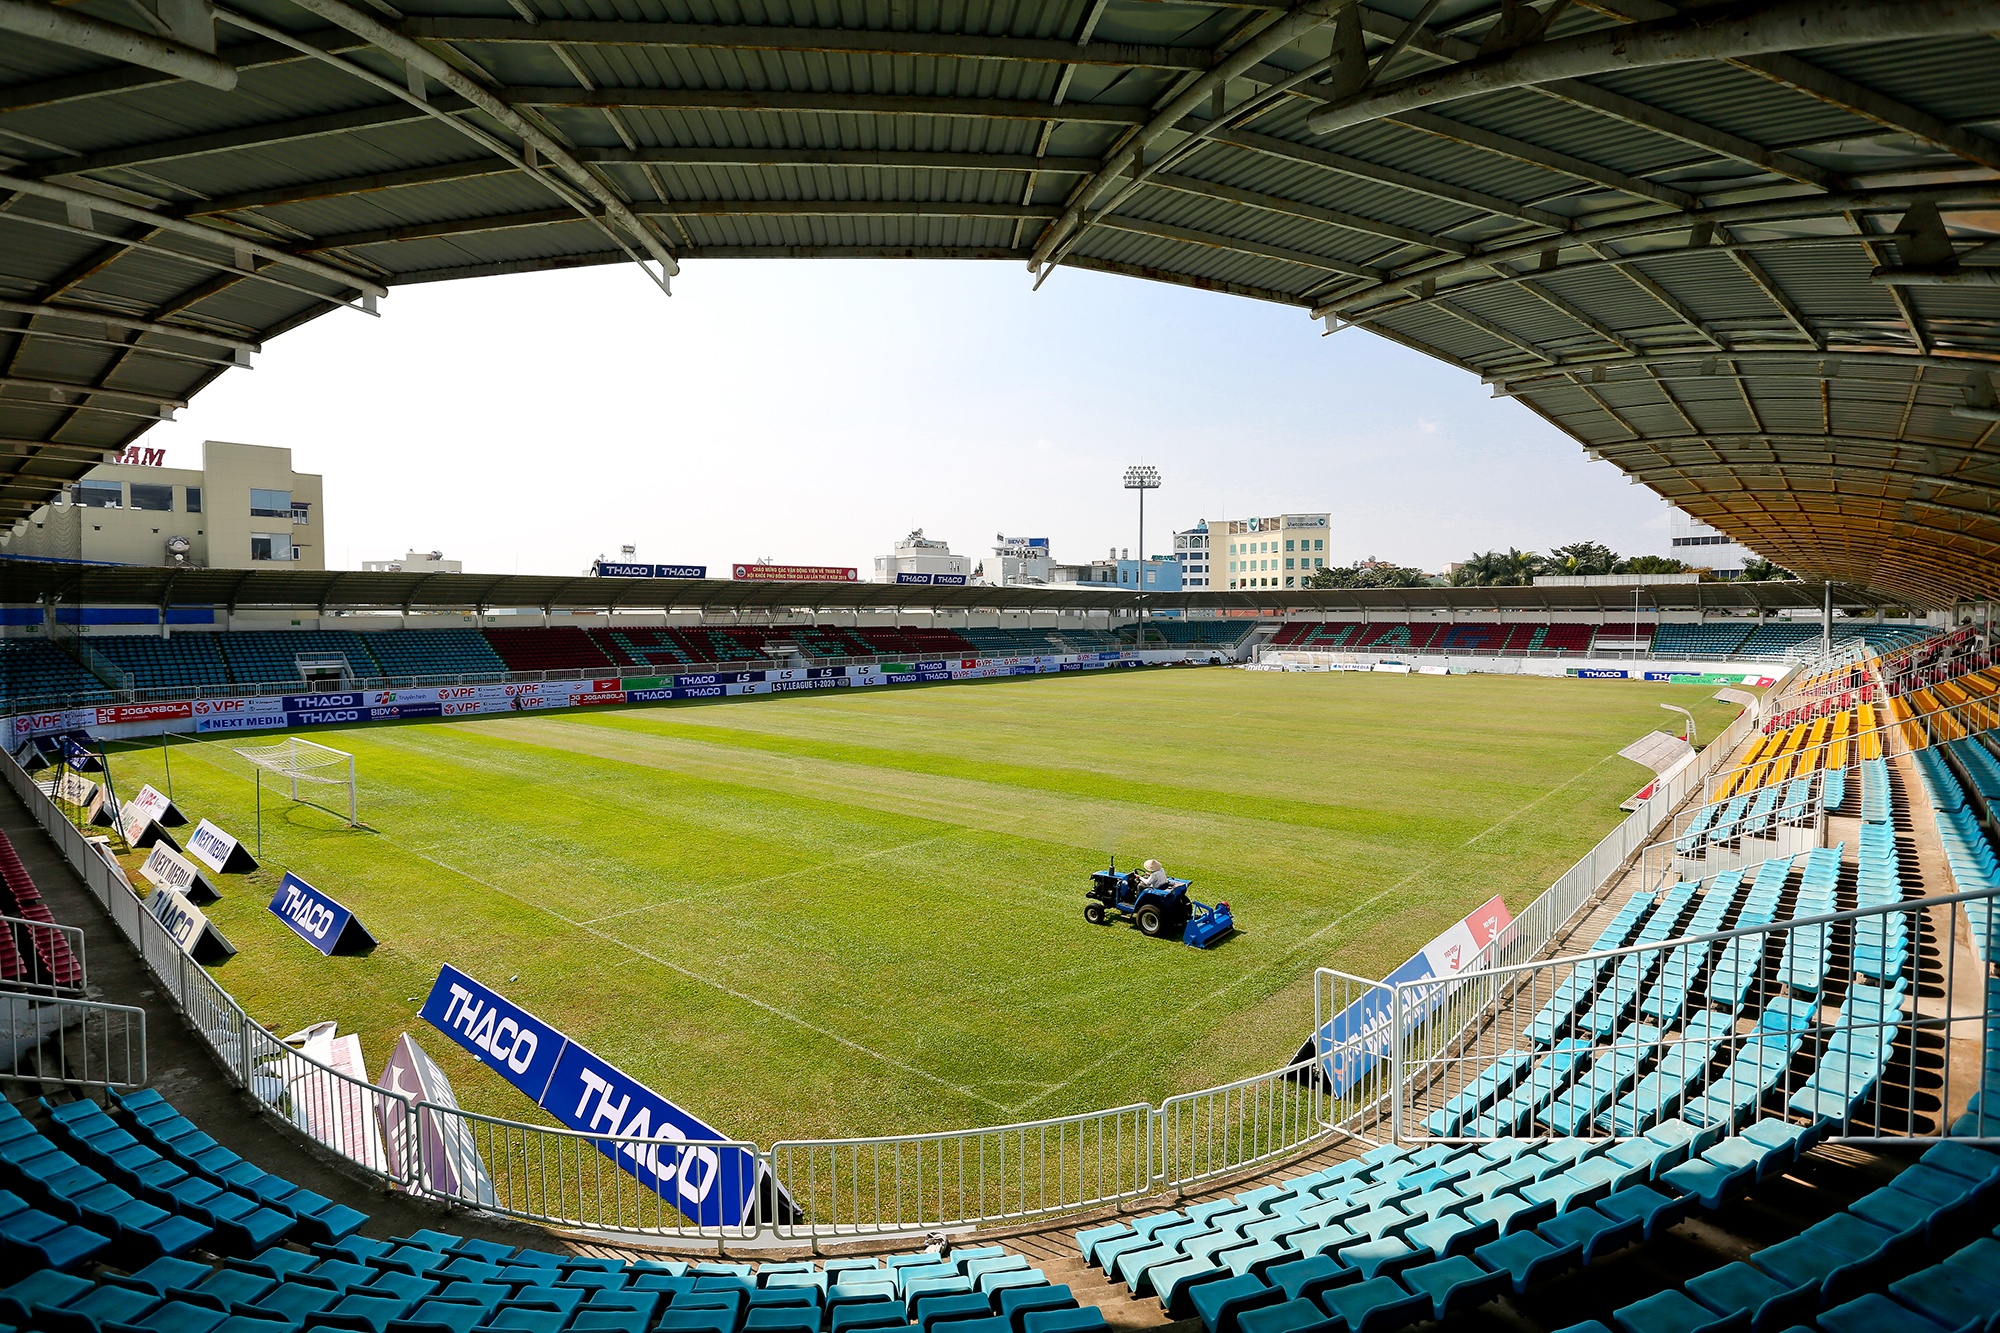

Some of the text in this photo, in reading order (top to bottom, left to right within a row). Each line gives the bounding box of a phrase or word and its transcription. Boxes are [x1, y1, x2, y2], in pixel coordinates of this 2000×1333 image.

[606, 565, 648, 576] THACO
[661, 567, 701, 577] THACO
[901, 575, 928, 583] THACO
[857, 666, 869, 675] LS
[919, 662, 943, 670] THACO
[737, 673, 750, 682] LS
[780, 670, 792, 679] LS
[820, 668, 832, 677] LS
[925, 672, 948, 680] THACO
[680, 675, 715, 685] THACO
[863, 677, 874, 685] LS
[891, 674, 917, 683] THACO
[516, 684, 539, 694] VPF
[742, 685, 755, 694] LS
[773, 683, 781, 692] LS
[783, 681, 813, 691] V.LEAGUE
[451, 688, 475, 698] VPF
[583, 693, 624, 701] JOGARBOLA
[634, 690, 672, 700] THACO
[685, 687, 720, 697] THACO
[294, 695, 353, 708] THACO
[375, 692, 397, 705] FPT
[522, 697, 544, 707] VPF
[120, 704, 189, 716] JOGARBOLA
[212, 700, 244, 712] VPF
[457, 702, 480, 712] VPF
[98, 708, 115, 716] JG
[371, 708, 391, 716] BIDV
[31, 714, 61, 728] VPF
[213, 716, 285, 728] NEXT MEDIA
[299, 711, 358, 724] THACO
[196, 829, 231, 863] NEXT MEDIA
[151, 851, 191, 886] NEXT MEDIA
[152, 889, 194, 945] TACO
[281, 884, 335, 940] THACO
[443, 982, 538, 1075] THACO
[574, 1067, 719, 1204] THACO
